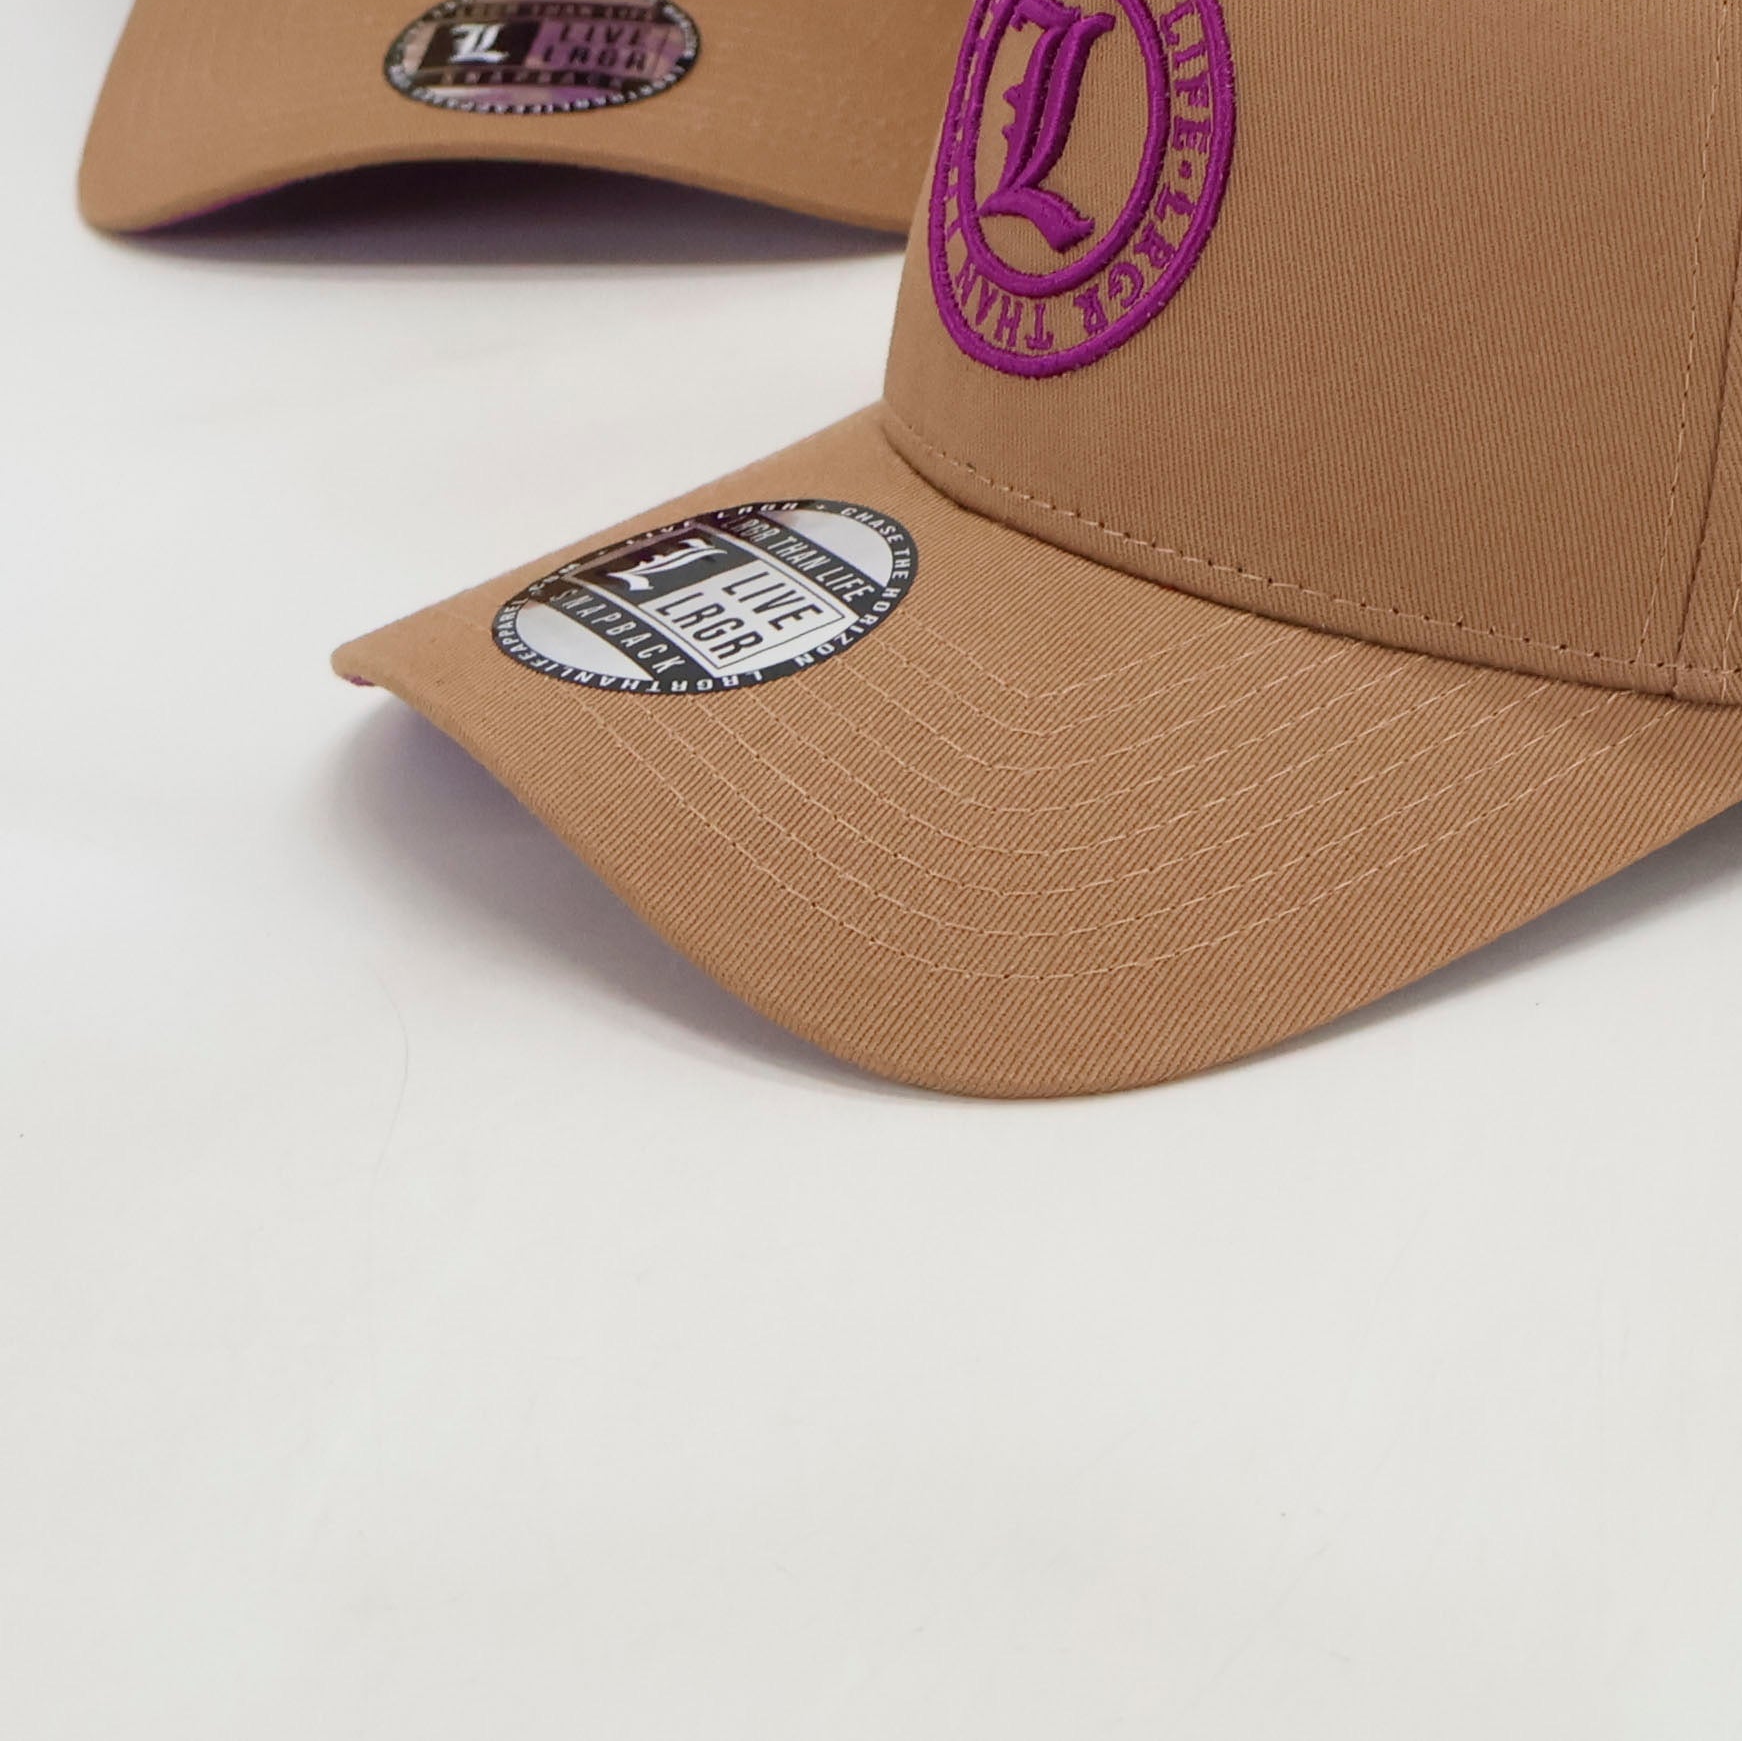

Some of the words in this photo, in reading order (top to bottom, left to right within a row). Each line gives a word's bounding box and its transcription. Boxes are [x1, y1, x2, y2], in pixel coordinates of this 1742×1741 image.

[1073, 181, 1199, 335] LRGR
[955, 256, 1054, 350] THAN
[841, 507, 905, 544] CHASE
[767, 536, 832, 572] THAN
[816, 566, 876, 603] LIFE
[892, 547, 911, 579] THE
[549, 589, 686, 674] SNAPBACK
[655, 592, 764, 659] LRGR
[722, 571, 824, 631] LIVE
[794, 587, 901, 667] HORIZON
